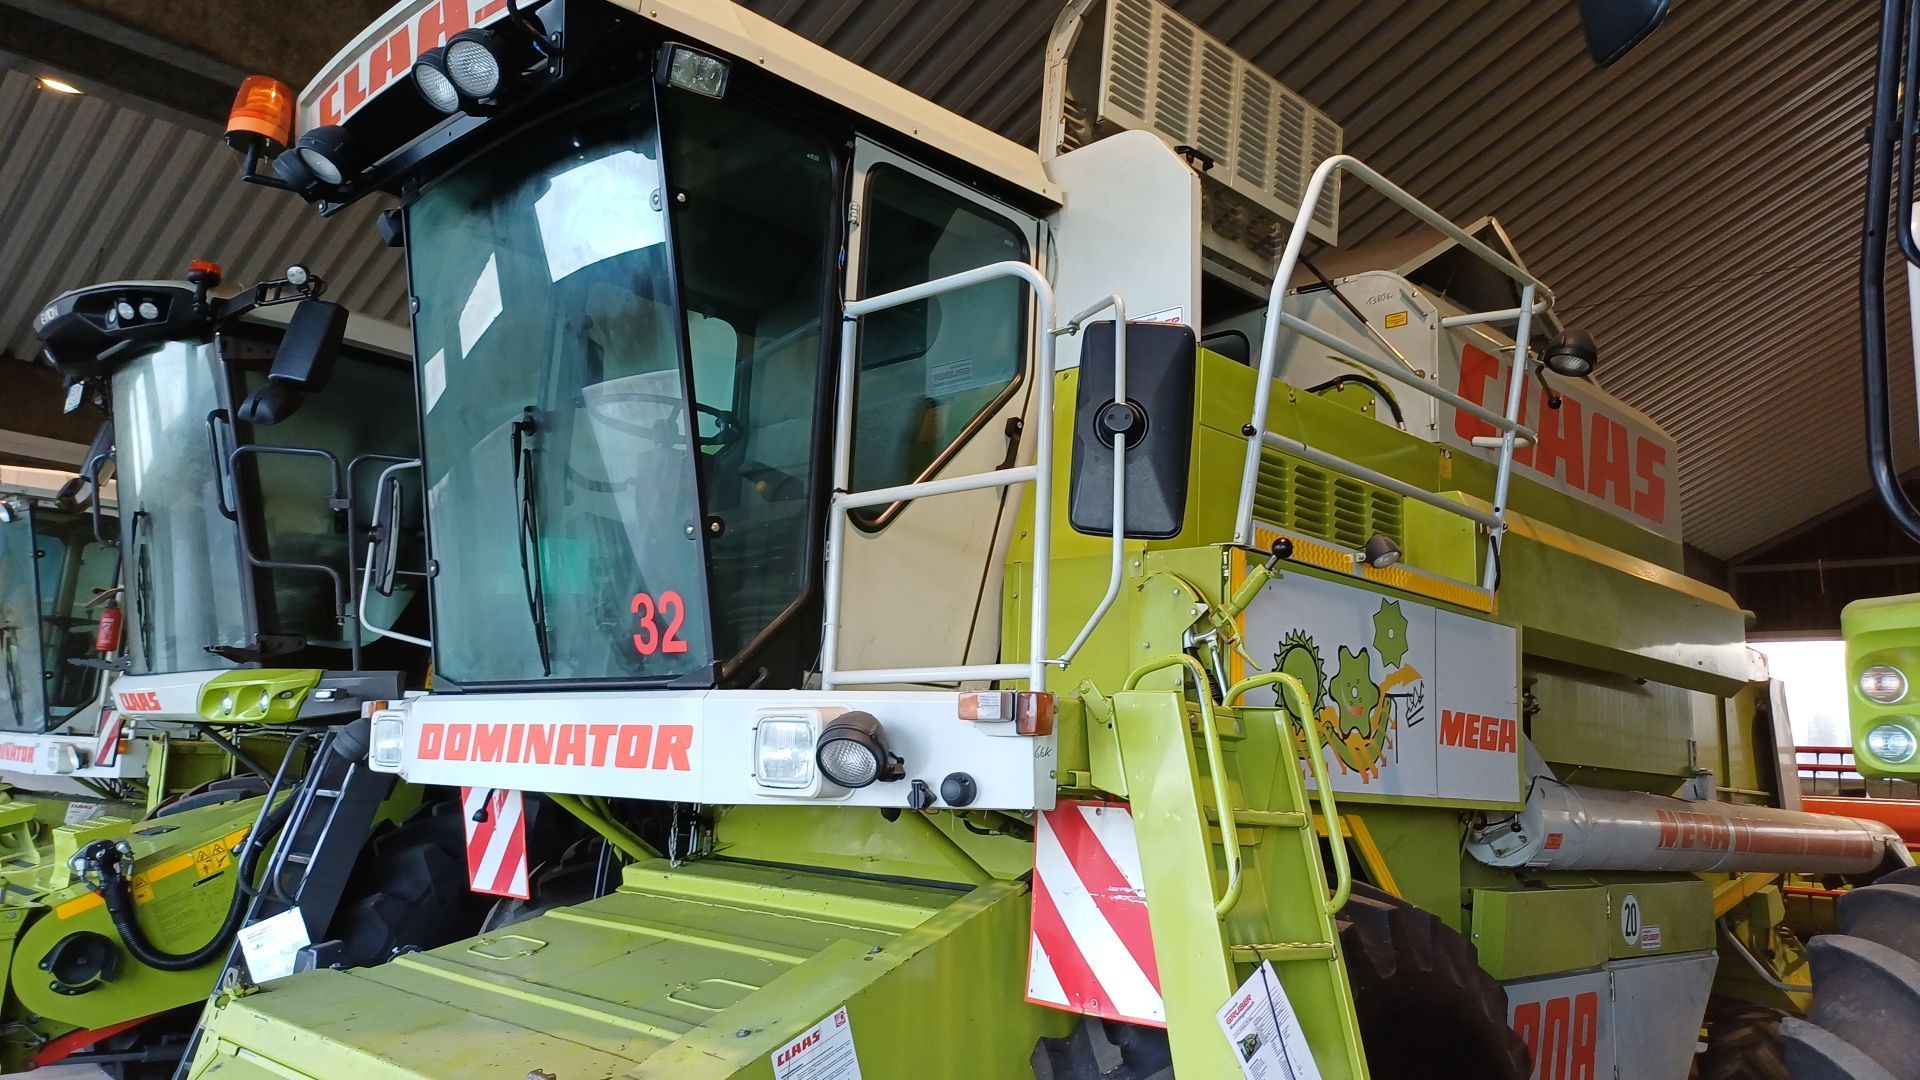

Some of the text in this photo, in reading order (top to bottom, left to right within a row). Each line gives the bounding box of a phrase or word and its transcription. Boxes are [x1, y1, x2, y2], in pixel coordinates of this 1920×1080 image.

[1454, 342, 1667, 525] CLAAS
[631, 590, 688, 655] 32
[118, 692, 162, 711] CLAAS
[417, 723, 694, 771] DOMINATOR
[1439, 709, 1517, 753] MEGA
[1624, 902, 1637, 937] 20
[1225, 994, 1252, 1025] GRUBER
[777, 1029, 821, 1067] CLAAS
